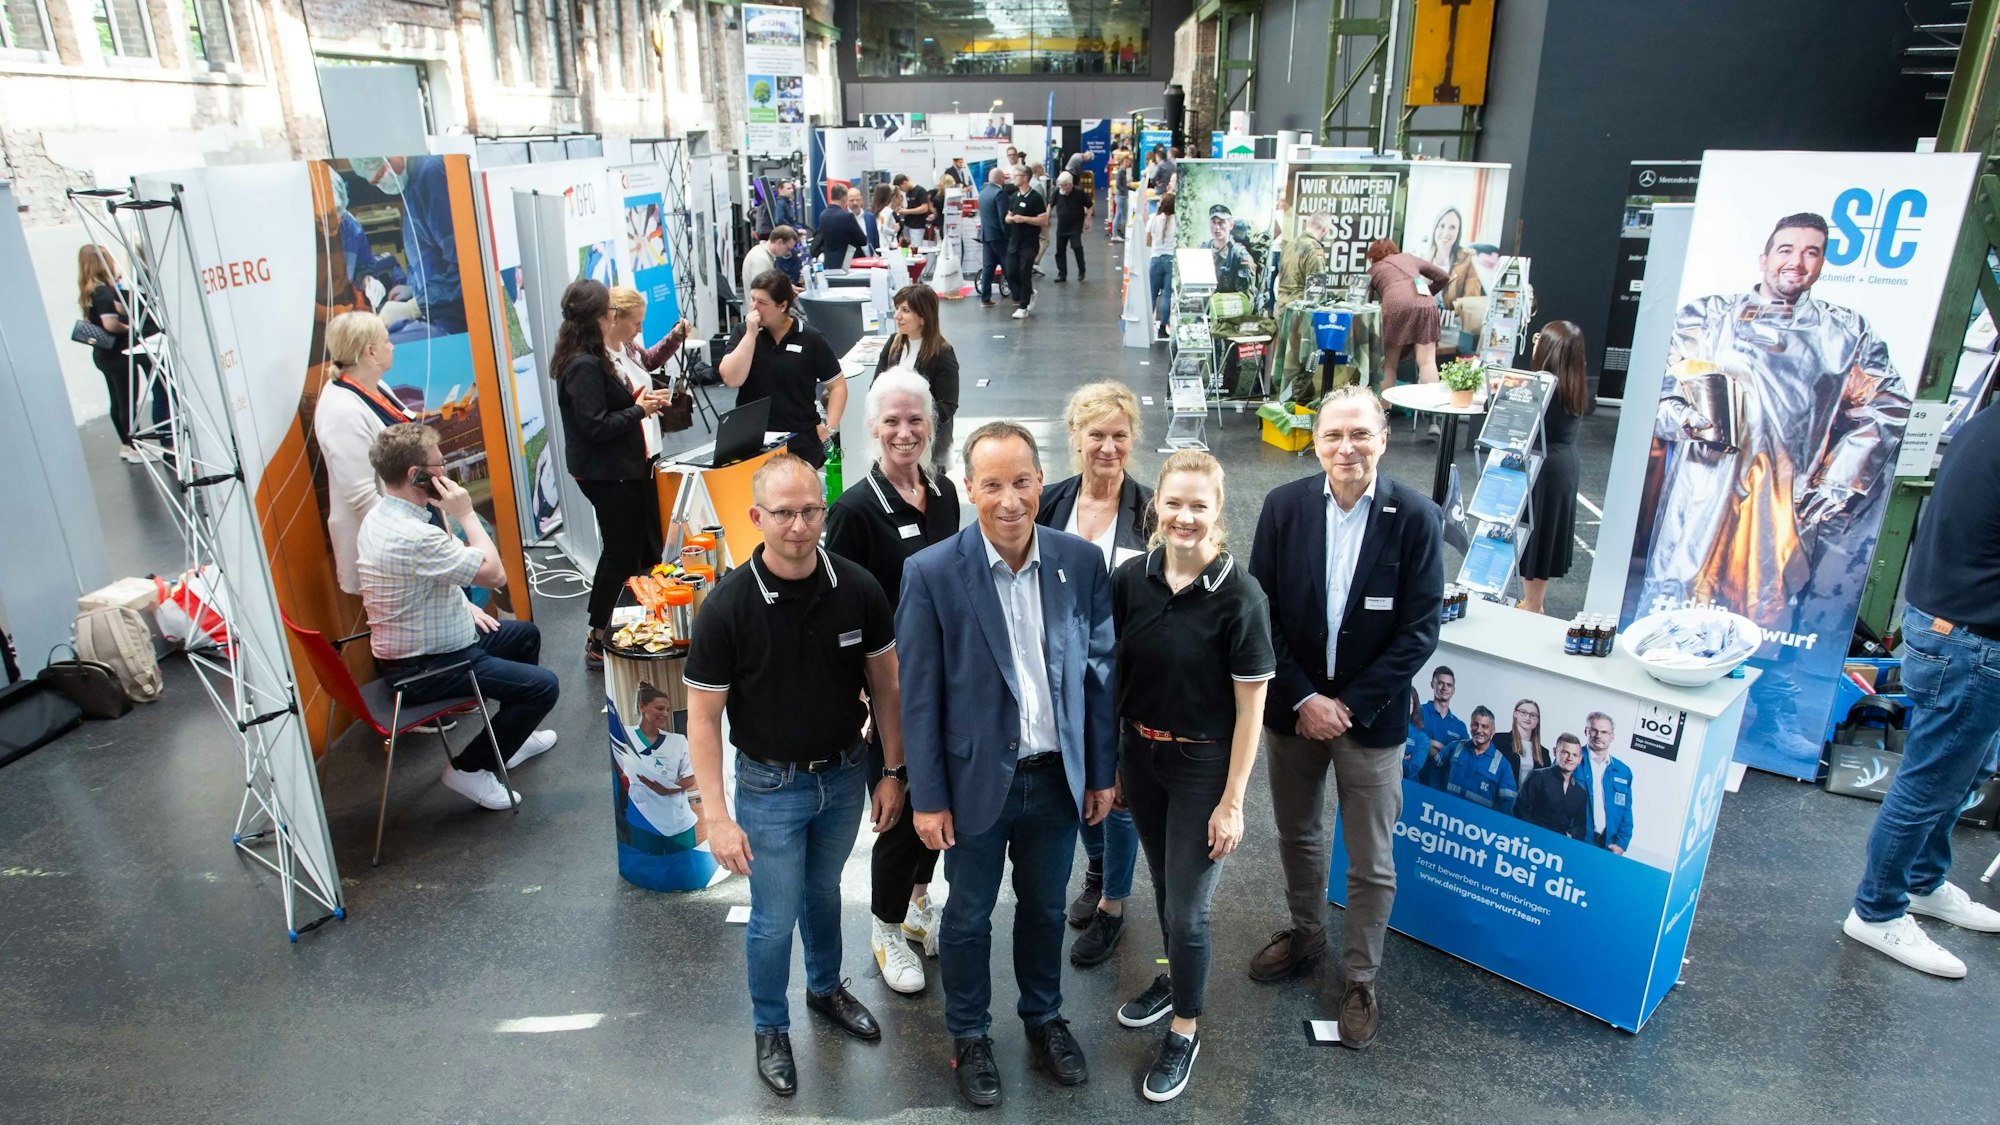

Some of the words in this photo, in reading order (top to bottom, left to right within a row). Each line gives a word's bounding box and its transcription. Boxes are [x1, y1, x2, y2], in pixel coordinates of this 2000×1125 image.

[1301, 178, 1328, 194] WIR
[1331, 176, 1393, 195] KÄMPFEN
[1659, 176, 1699, 184] Mercedes-Ben
[575, 182, 596, 217] GFO
[1299, 197, 1337, 213] AUCH
[1341, 195, 1390, 215] DAFÜR,
[1297, 215, 1354, 240] DSS
[1358, 215, 1389, 240] DU
[201, 258, 272, 295] ERBERG
[1867, 276, 1909, 286] Clemens
[1760, 627, 1818, 650] wurf
[1641, 717, 1672, 735] 100
[1420, 802, 1563, 873] Innovation
[1415, 857, 1436, 870] Jetzt
[1437, 864, 1480, 888] bewerben
[1481, 884, 1499, 895] und
[1500, 891, 1551, 916] einbringen:
[1494, 854, 1538, 888] bei
[1544, 876, 1588, 908] dir.
[1419, 871, 1541, 926] www.deingrosserwurf.team
